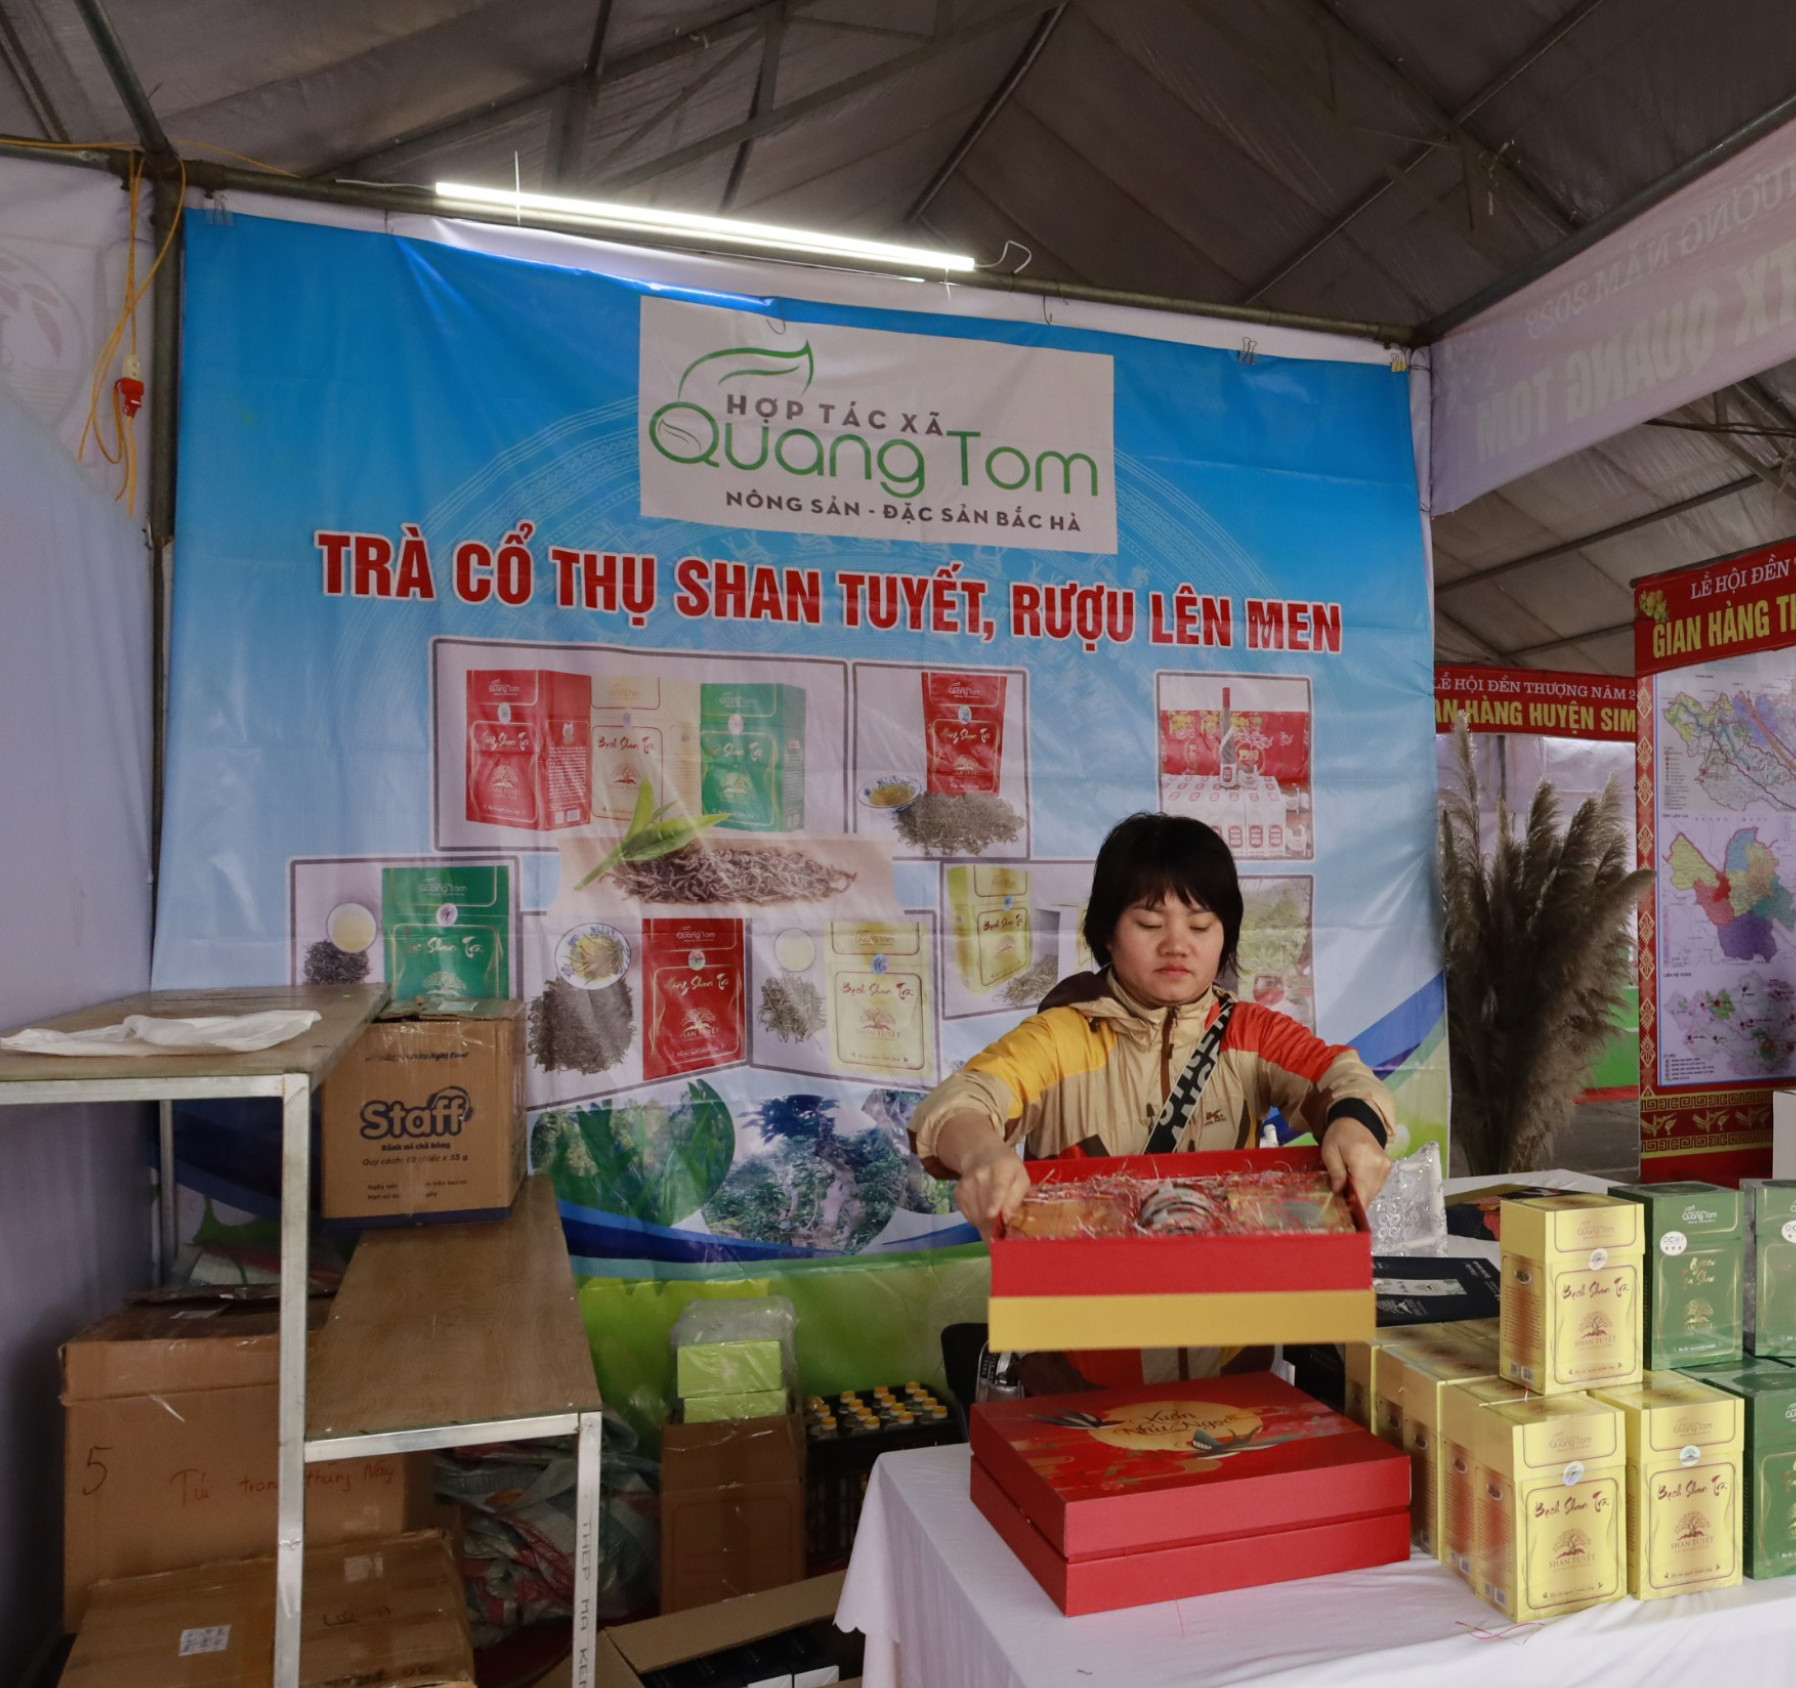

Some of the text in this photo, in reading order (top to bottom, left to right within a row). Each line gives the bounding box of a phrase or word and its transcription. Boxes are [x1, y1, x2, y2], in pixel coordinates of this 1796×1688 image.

[726, 394, 945, 437] HỢP TÁC XÃ
[649, 401, 1098, 498] Quang Tom
[726, 489, 1081, 532] NÔNG SẢN ĐẶC SẢN BẮC HÀ
[315, 521, 1342, 653] TRÀ CỔ THỤ SHAN TUYẾT, RƯỢU LÊN MEN
[1690, 571, 1714, 600] LỄ
[1715, 567, 1748, 600] HỘI
[1751, 552, 1792, 584] ĐỀN
[1652, 614, 1702, 660] GIAN
[1707, 593, 1771, 645] HÀNG
[1454, 676, 1483, 697] HỘI
[1487, 674, 1520, 695] ĐỀN
[1522, 681, 1589, 702] THƯỢNG
[1591, 679, 1628, 701] NĂM
[1465, 694, 1523, 728] HÀNG
[1530, 699, 1595, 734] HUYỆN
[1600, 705, 1636, 734] SIM
[360, 1094, 464, 1141] Staff
[82, 1446, 113, 1495] 5
